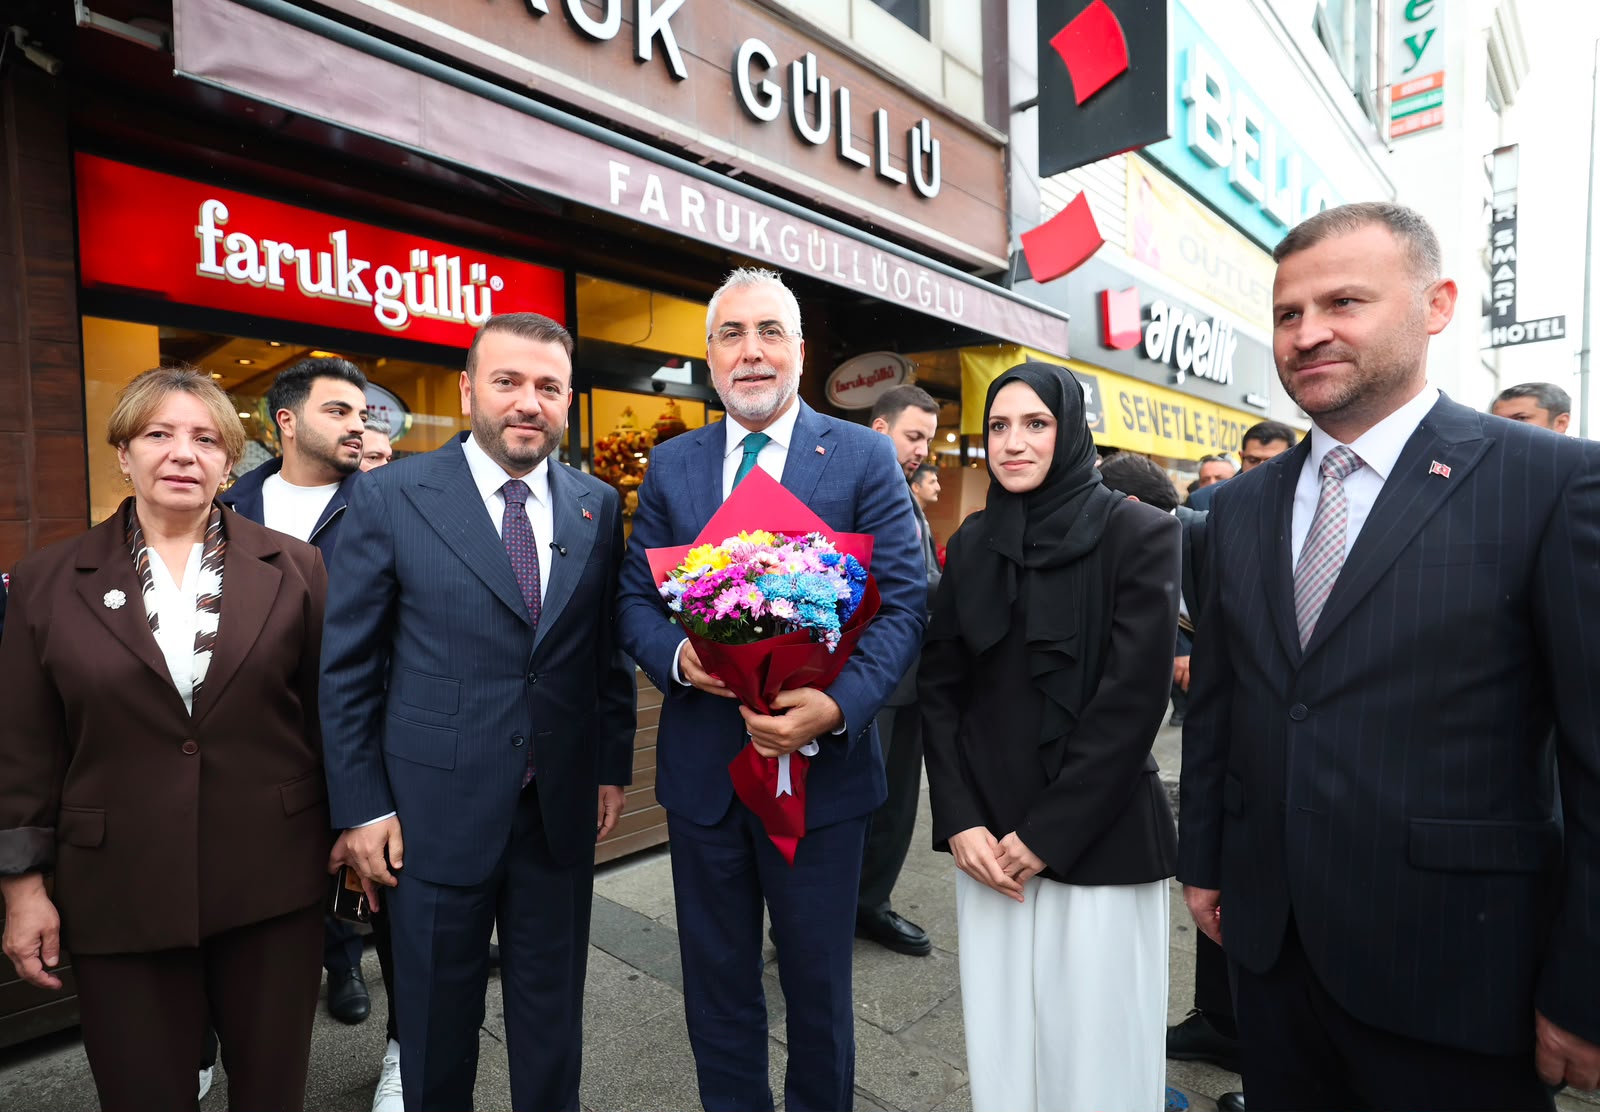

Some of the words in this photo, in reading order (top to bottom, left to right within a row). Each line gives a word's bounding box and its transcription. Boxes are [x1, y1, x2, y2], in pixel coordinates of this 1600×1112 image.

[735, 37, 941, 199] GÜLLÜ
[1492, 227, 1517, 317] SMART
[1144, 299, 1238, 385] arçelik
[1492, 317, 1565, 346] HOTEL
[1119, 391, 1206, 445] SENETLE
